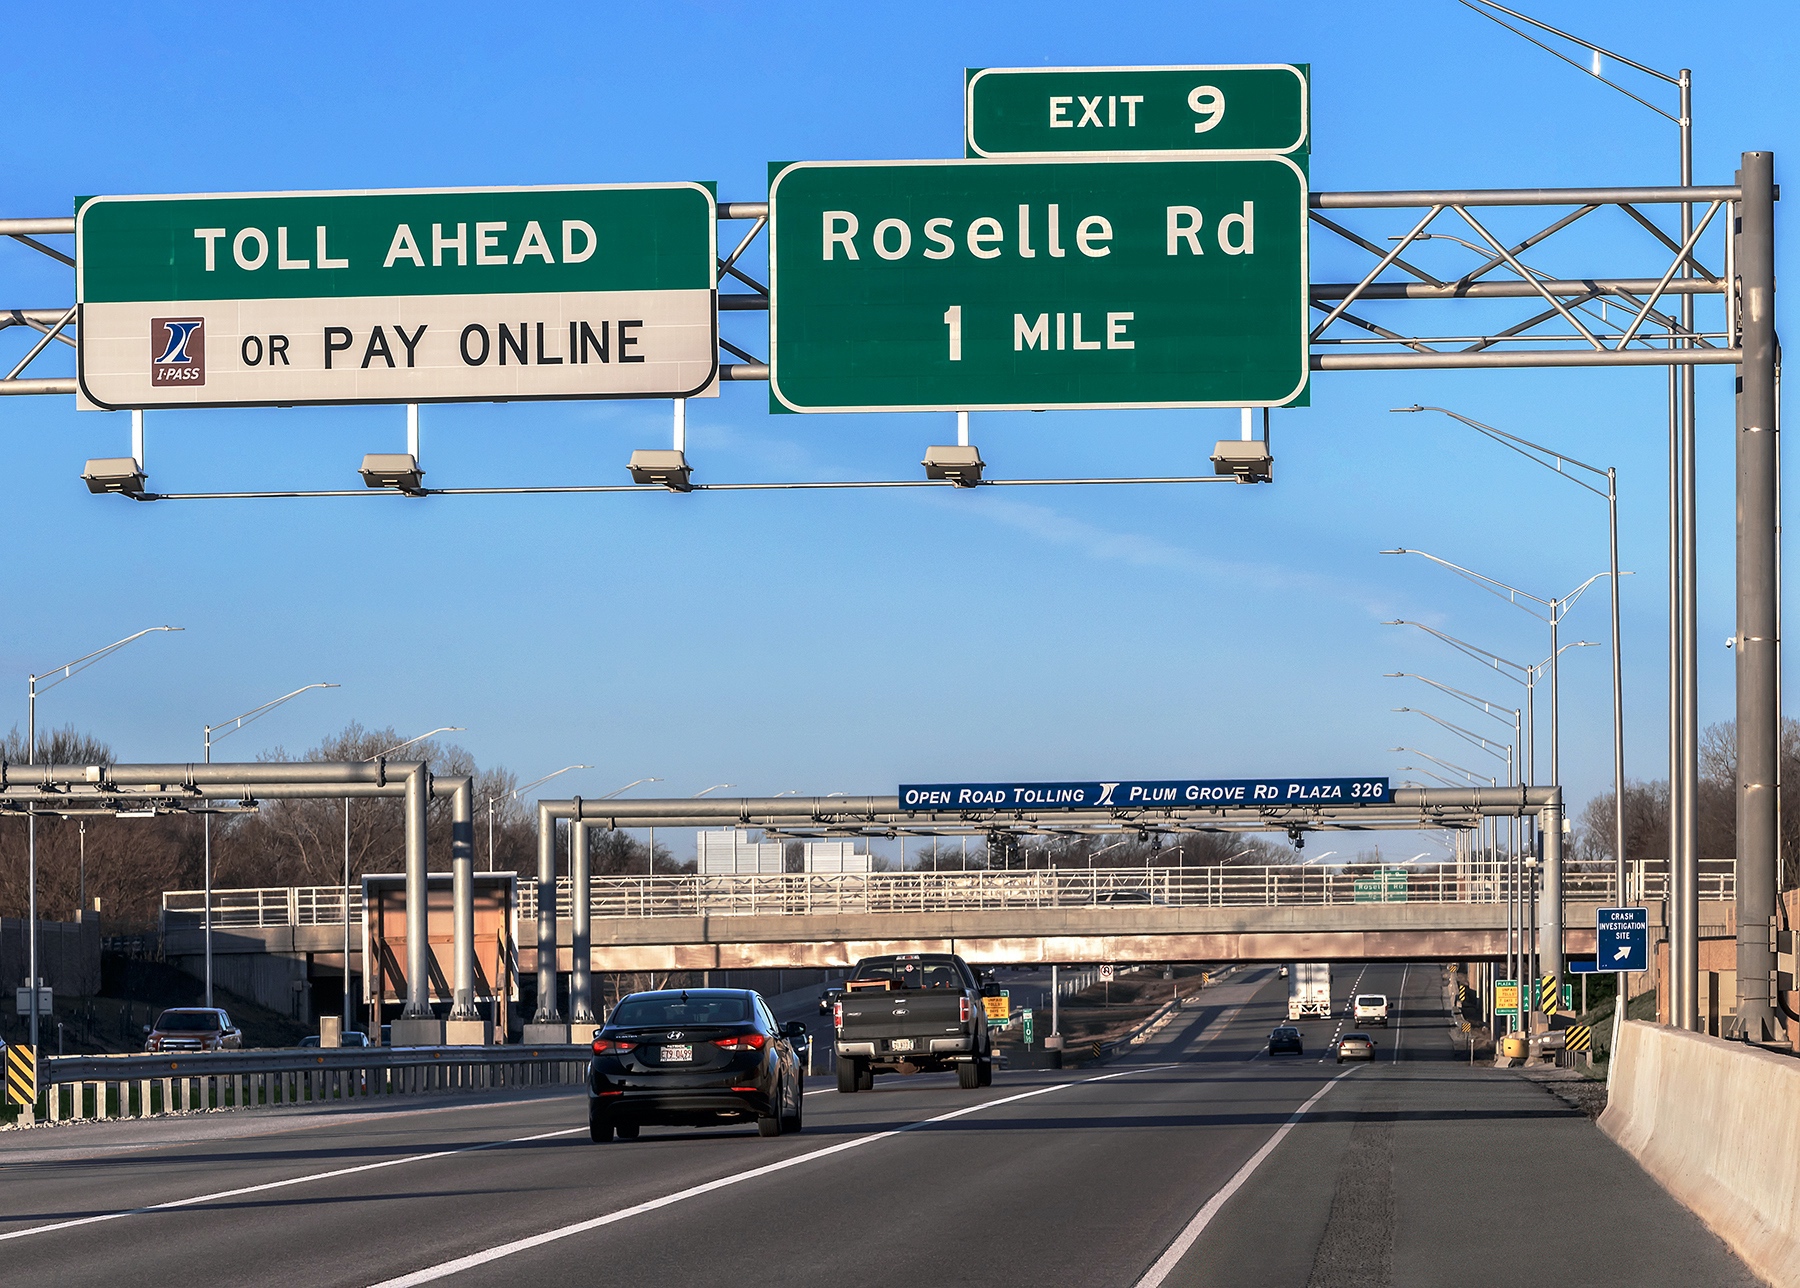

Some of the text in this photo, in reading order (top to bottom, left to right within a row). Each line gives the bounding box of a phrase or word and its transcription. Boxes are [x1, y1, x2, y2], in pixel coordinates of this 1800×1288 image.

[1049, 85, 1225, 133] EXIT 9
[193, 219, 598, 272] TOLL AHEAD
[822, 201, 1254, 261] Roselle Rd
[240, 320, 645, 369] OR PAY ONLINE
[943, 305, 1136, 362] 1 MILE
[905, 781, 1383, 805] OPEN ROAD TOLLING PLUM GROVE RD PLAZA 326
[1599, 922, 1645, 930] INVESTIGATION
